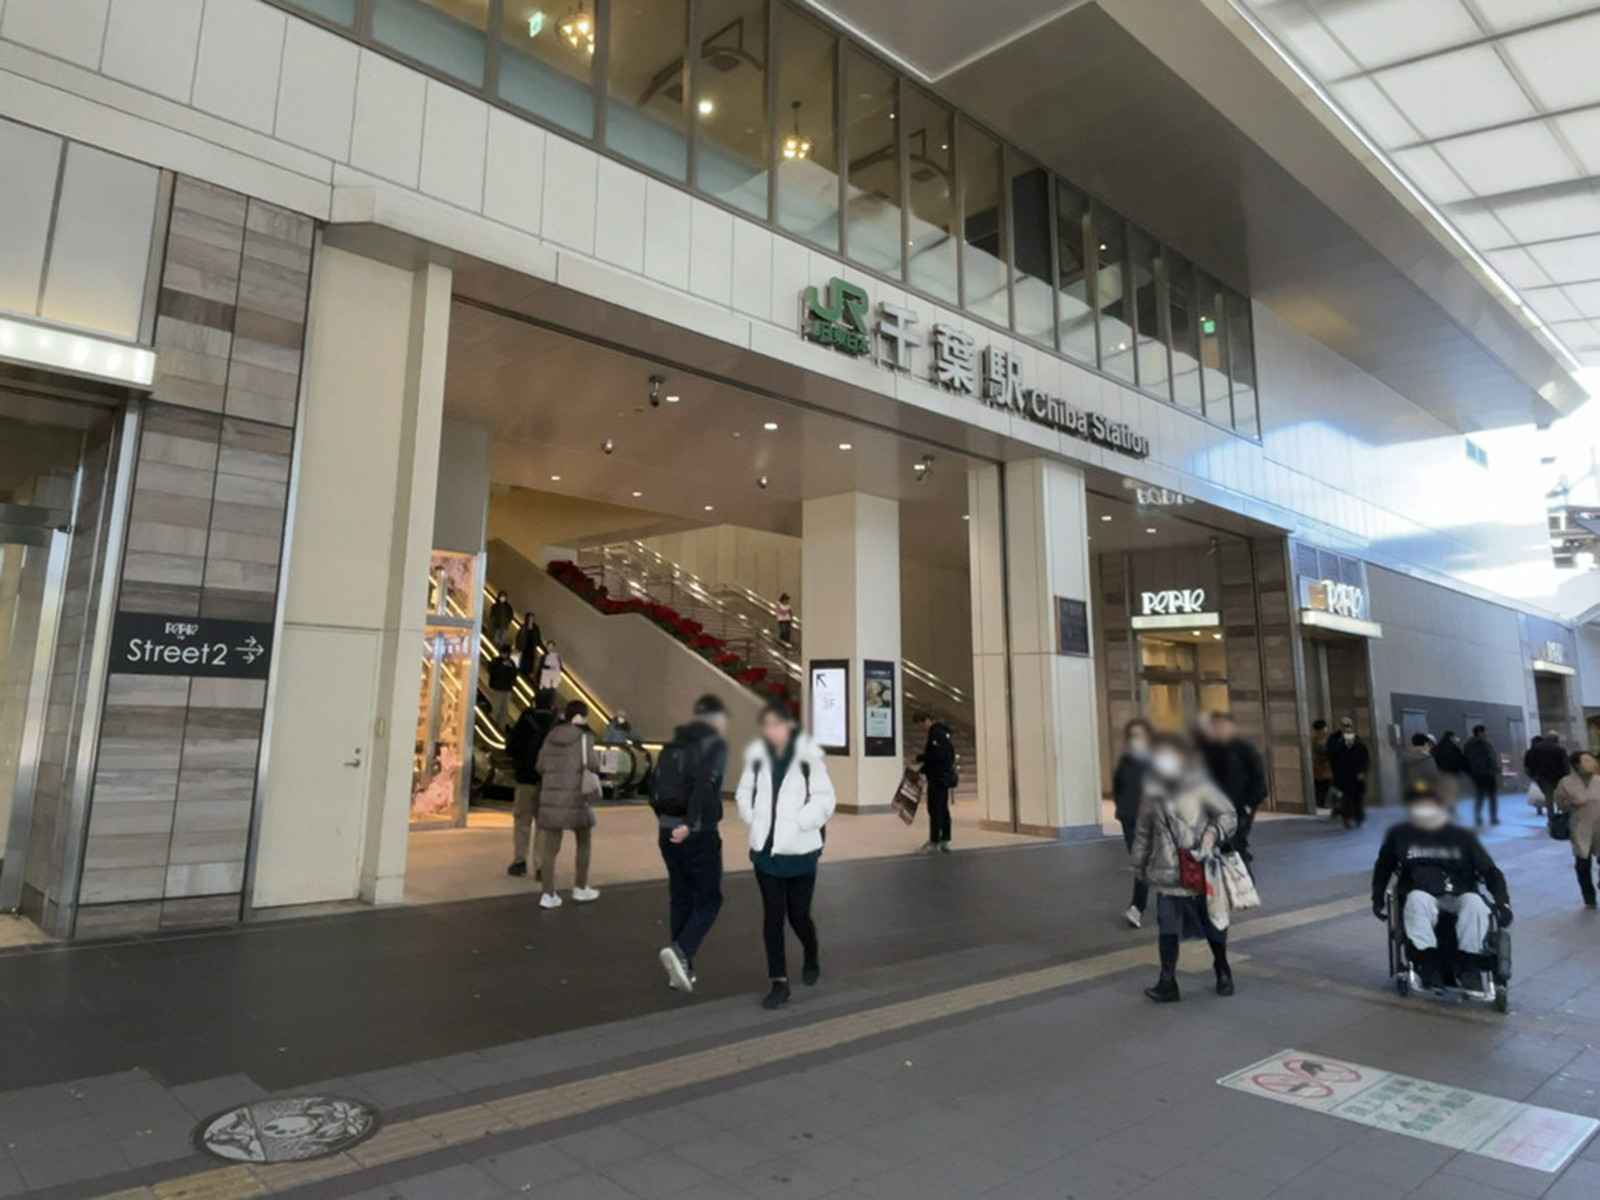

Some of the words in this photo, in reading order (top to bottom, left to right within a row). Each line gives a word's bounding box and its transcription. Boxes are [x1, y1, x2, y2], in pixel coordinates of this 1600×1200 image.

[805, 277, 869, 334] JR
[879, 303, 1025, 411] 千葉駅
[1030, 387, 1088, 433] Chiba
[1092, 412, 1150, 456] Station
[126, 637, 229, 666] Street2
